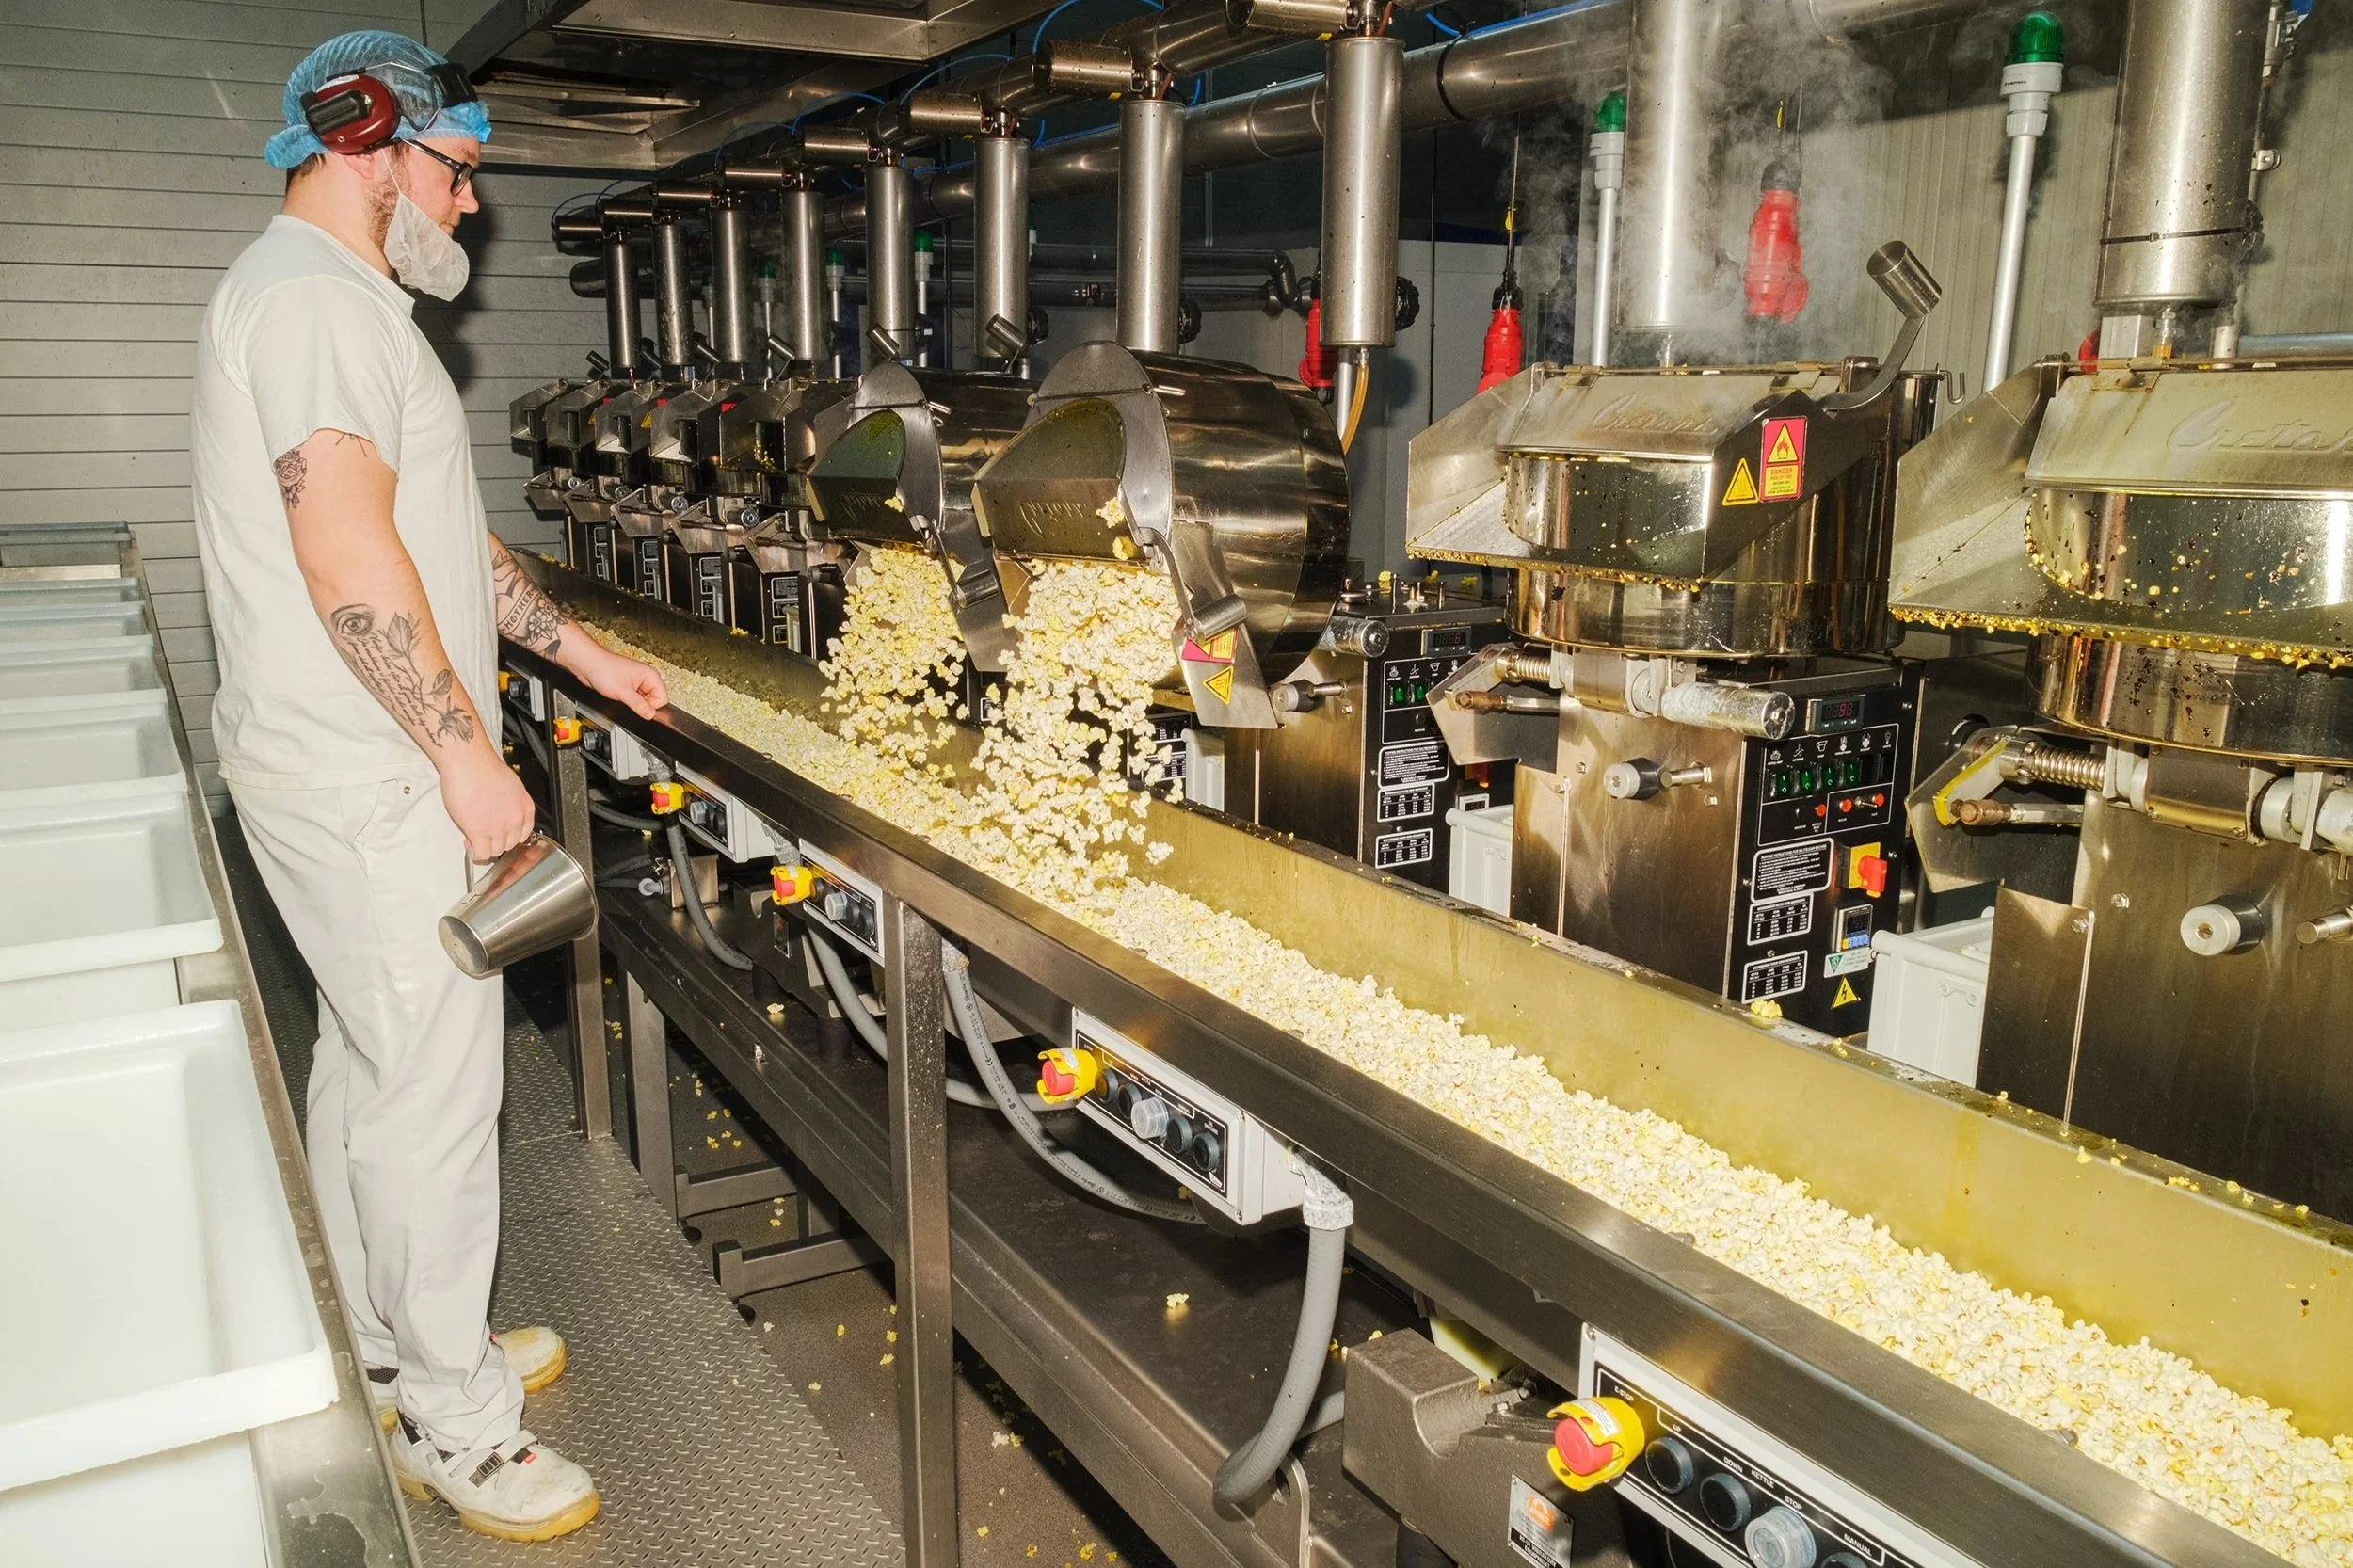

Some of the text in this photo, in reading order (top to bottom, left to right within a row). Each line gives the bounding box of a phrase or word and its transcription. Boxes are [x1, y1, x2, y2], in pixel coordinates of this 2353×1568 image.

[1770, 467, 1793, 475] DANGER
[504, 590, 534, 630] MOTHER
[1614, 1385, 1635, 1401] E-STOP
[1673, 1423, 1682, 1432] UP
[1723, 1456, 1743, 1473] DOWN
[1751, 1469, 1775, 1489] KETTLE
[1785, 1496, 1802, 1511] STOP
[1844, 1532, 1873, 1557] MANUAL
